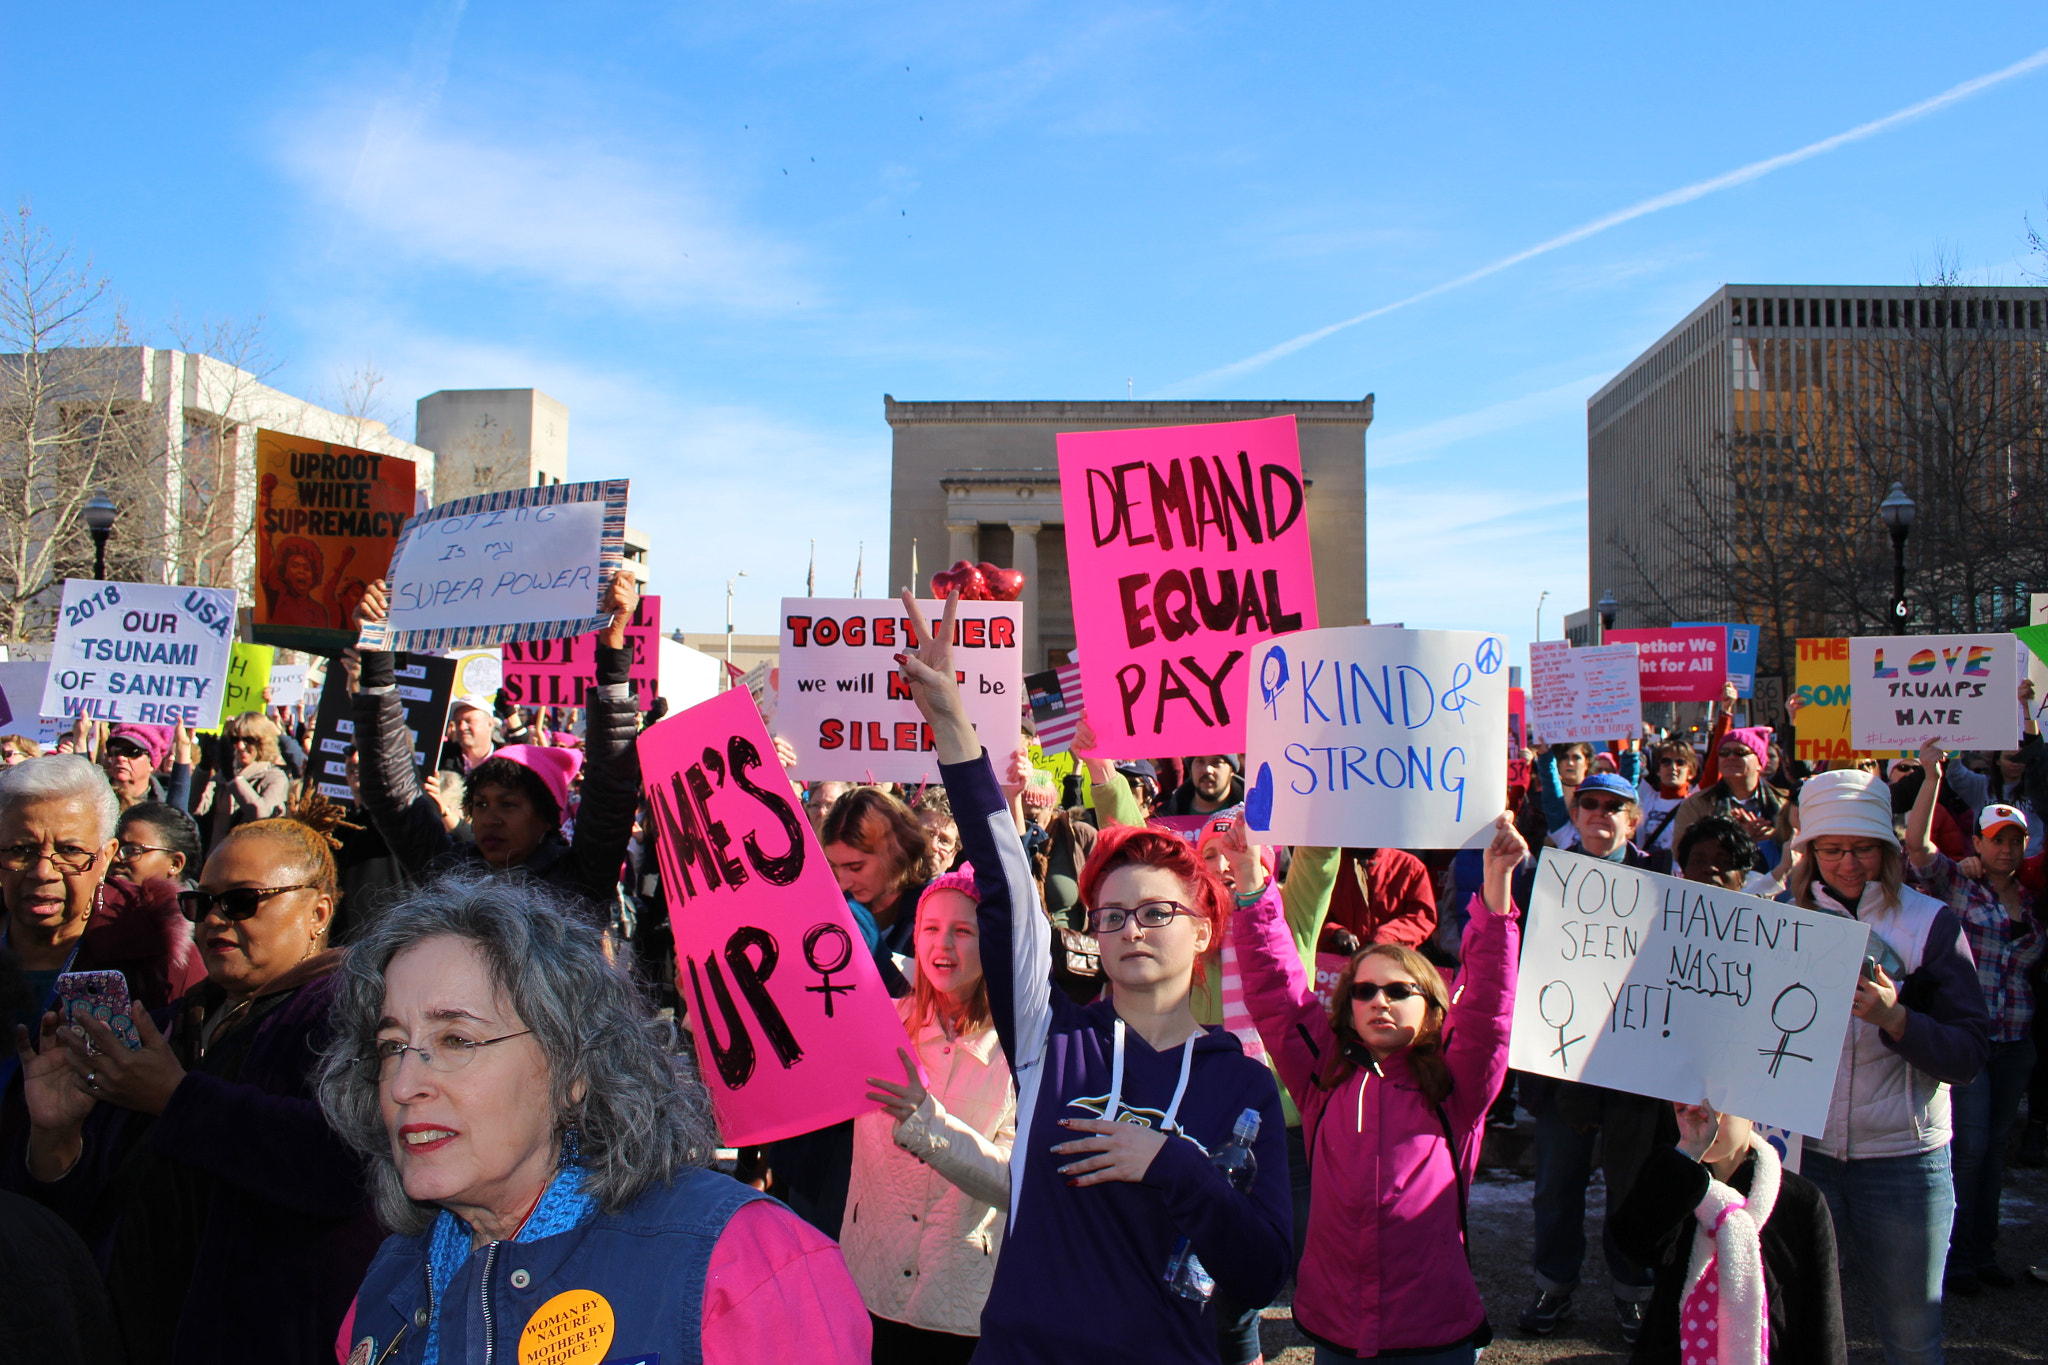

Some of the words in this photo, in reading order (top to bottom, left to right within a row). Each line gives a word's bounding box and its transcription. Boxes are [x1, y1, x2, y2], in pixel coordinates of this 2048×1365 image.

[290, 452, 383, 481] UPROOT
[297, 481, 372, 509] WHITE
[1086, 451, 1303, 552] DEMAND
[264, 507, 406, 538] SUPREMACY
[391, 577, 483, 611] SUPER
[491, 565, 592, 597] POWER
[65, 585, 121, 627] 2018
[122, 610, 178, 634] OUR
[184, 590, 230, 637] USA
[1118, 567, 1303, 649] EQUAL
[1895, 601, 1908, 617] 6
[81, 638, 198, 666] TSUNAMI
[1688, 638, 1717, 652] We
[1796, 637, 1849, 661] THE
[1659, 658, 1686, 673] for
[1688, 657, 1713, 672] All
[1872, 645, 1995, 678] LOVE
[60, 670, 96, 690] OF
[108, 672, 211, 699] SANITY
[798, 678, 826, 692] we
[837, 673, 874, 693] will
[979, 674, 1006, 695] be
[1115, 650, 1244, 736] PAY
[1301, 660, 1434, 730] KIND
[1440, 662, 1481, 725] &
[1797, 684, 1851, 707] SOM
[1888, 681, 1987, 698] TRUMPS
[63, 696, 123, 720] WILL
[138, 702, 199, 726] RISE
[1895, 708, 1963, 726] HATE
[819, 718, 938, 752] SILEN
[1284, 743, 1465, 823] STRONG
[1548, 859, 1639, 917] YOU
[1662, 888, 1813, 951] HAVEN'T
[1560, 920, 1637, 961] SEEN
[1669, 943, 1751, 1006] NASTY
[686, 926, 804, 1090] UP
[1603, 981, 1672, 1038] YET!
[526, 1306, 579, 1335] WOMAN
[582, 1297, 600, 1312] BY
[537, 1313, 591, 1343] NATURE
[527, 1331, 585, 1363] MOTHER
[588, 1322, 607, 1337] BY
